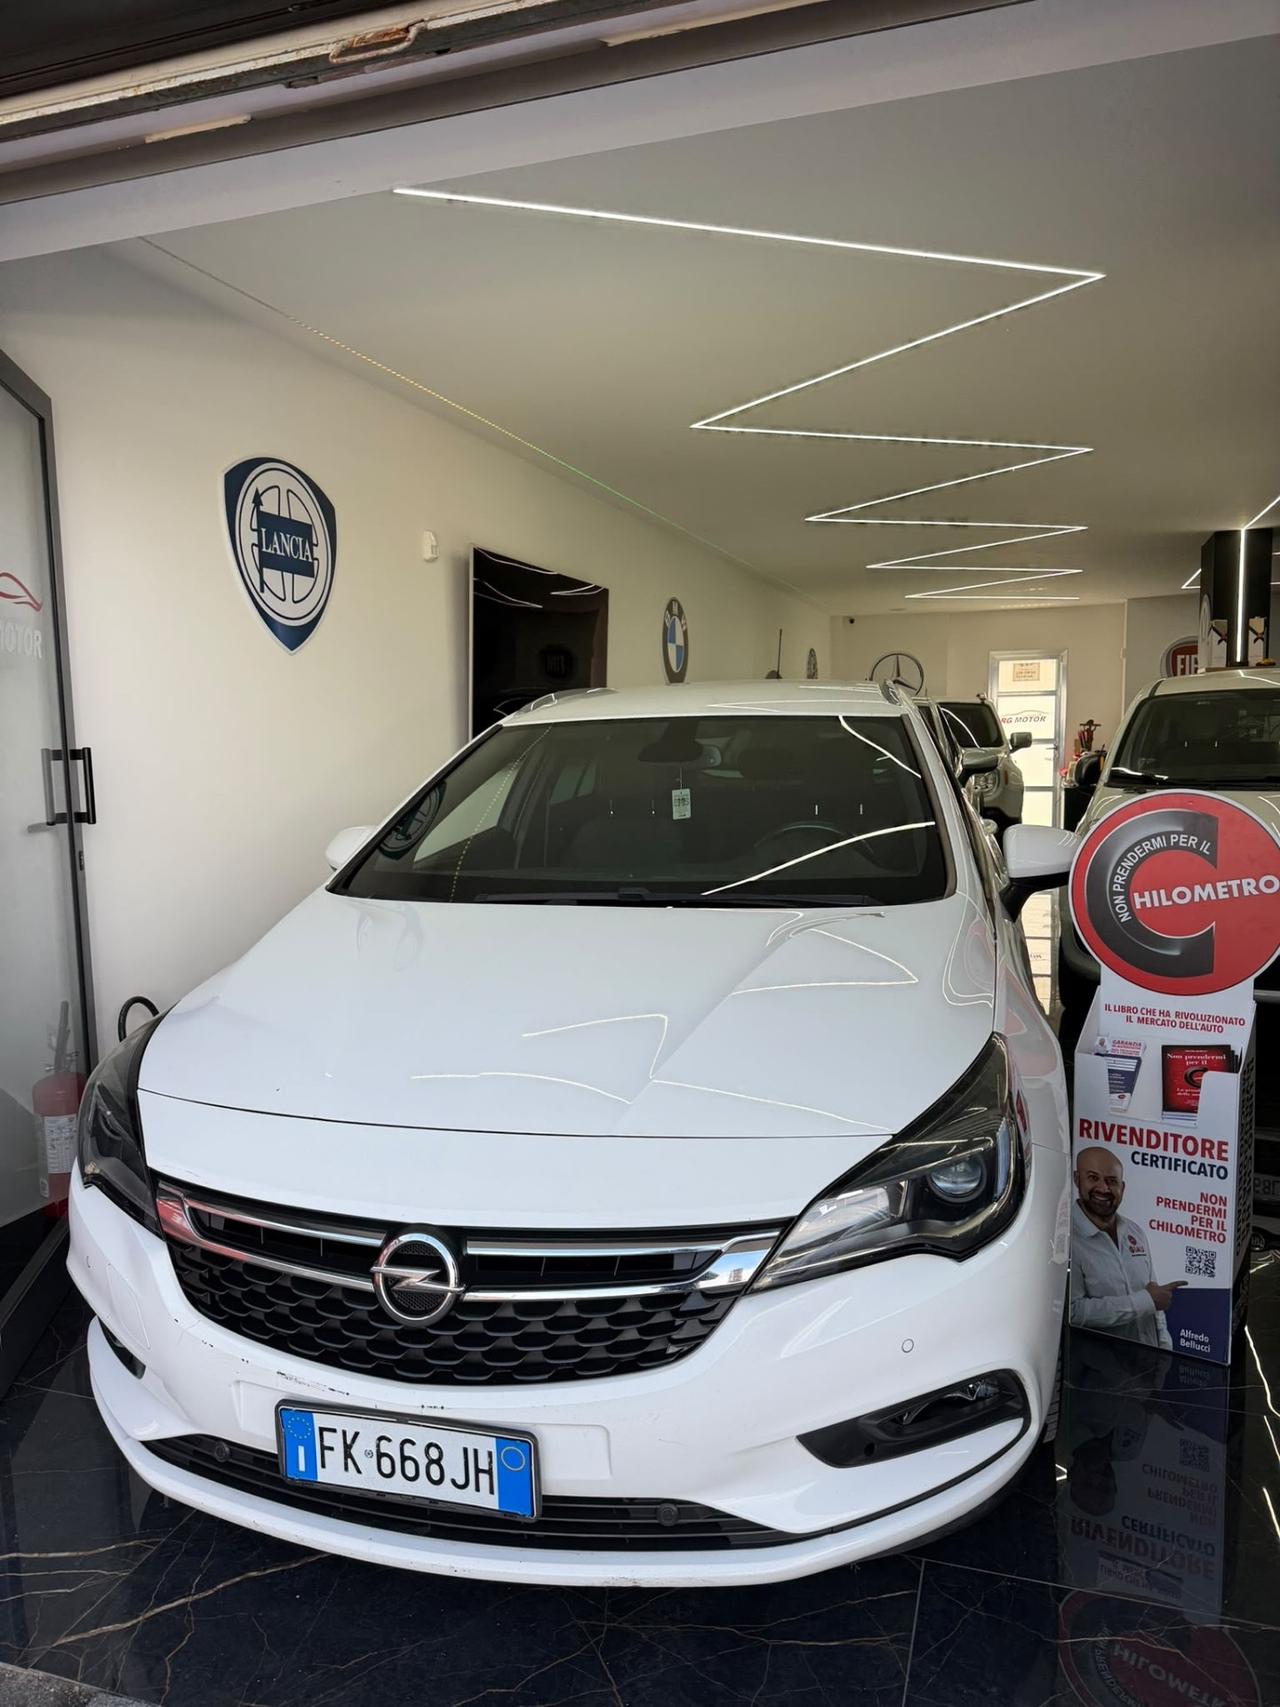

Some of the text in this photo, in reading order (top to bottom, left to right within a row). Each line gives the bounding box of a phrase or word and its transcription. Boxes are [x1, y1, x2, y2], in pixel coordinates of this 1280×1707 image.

[261, 528, 313, 562] LANCIA
[1014, 715, 1047, 723] MOTOR
[1112, 834, 1212, 923] NON PRENDERMI PER IL
[1104, 1003, 1246, 1026] IL LIBRO CHE HA RIVOLUZIONATO
[1126, 1015, 1224, 1033] IL MERCATO DELL'AUTO
[1079, 1118, 1229, 1162] RIVENDITORE
[1131, 1151, 1228, 1180] CERTIFICATO
[1156, 1196, 1227, 1219] PRENDERMI
[1200, 1192, 1227, 1207] NON
[1149, 1219, 1226, 1244] CHILOMETRO
[1190, 1216, 1227, 1232] PER IL
[1180, 1328, 1209, 1343] Alfredo
[1180, 1337, 1211, 1353] Bellucci
